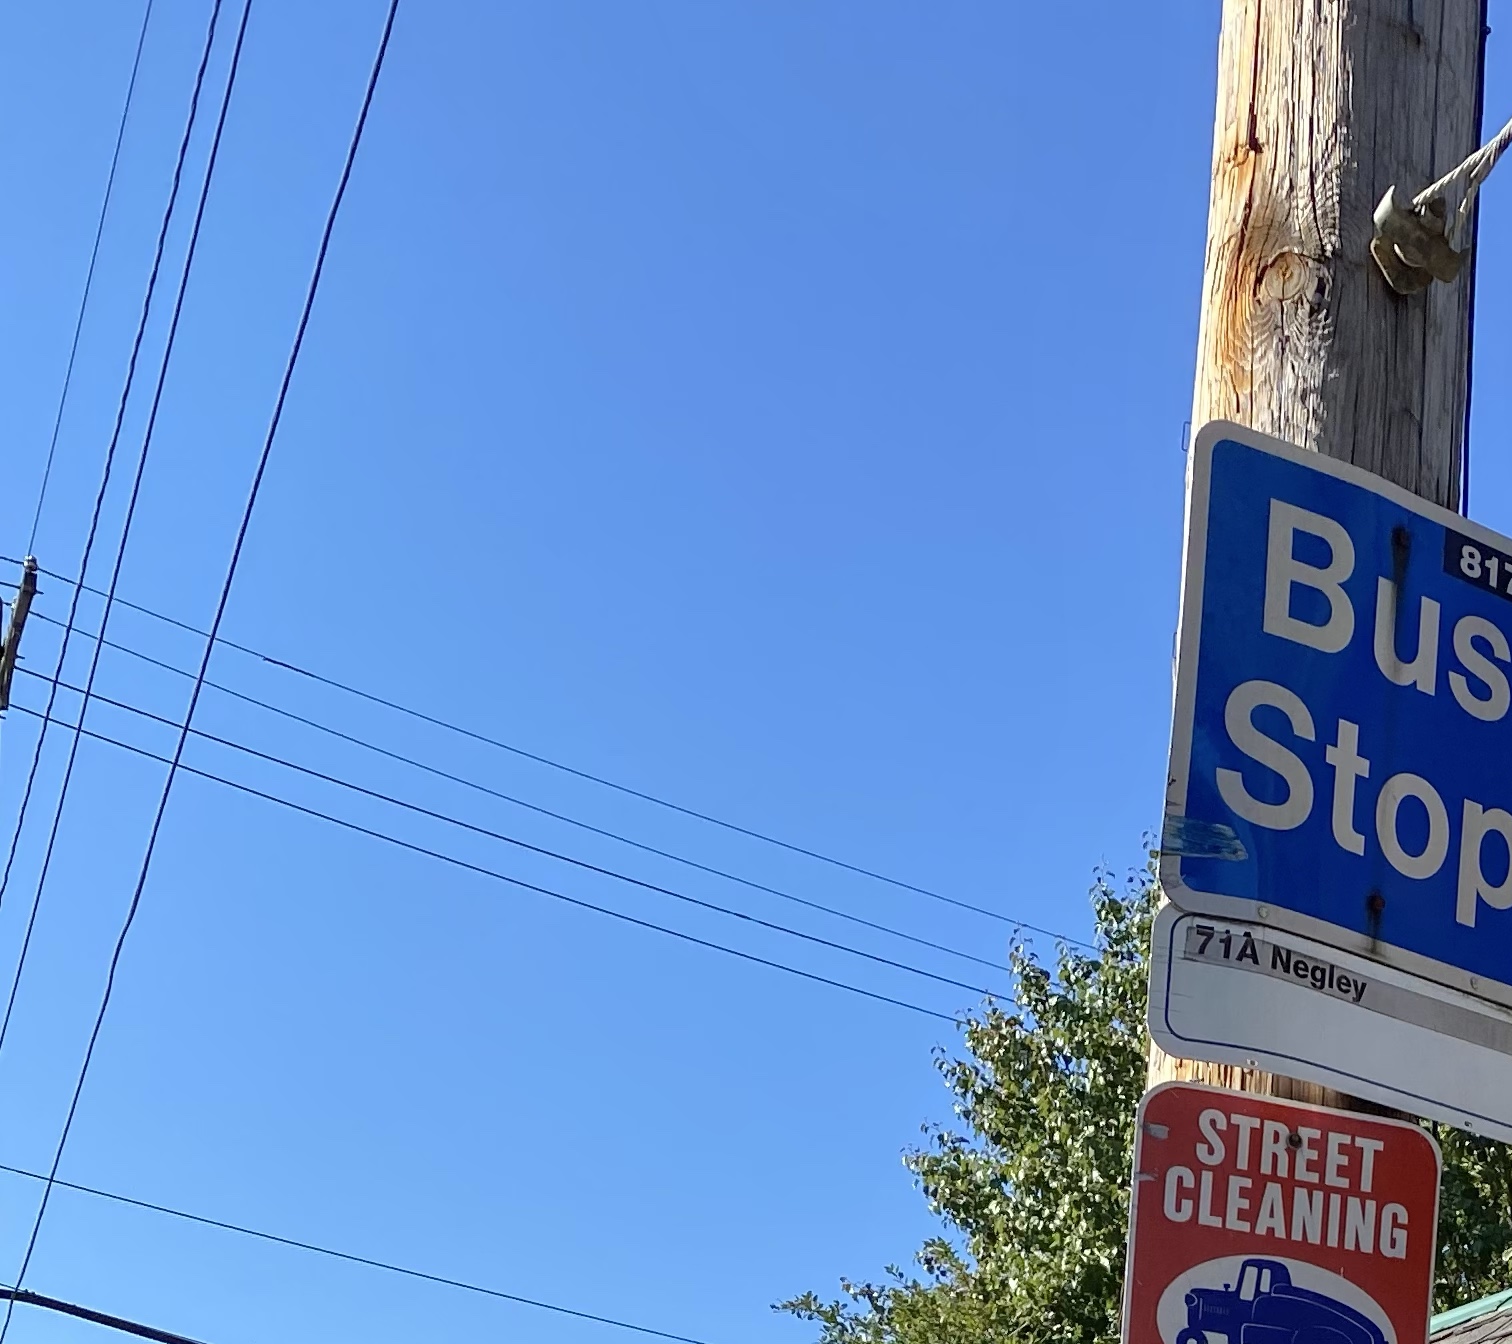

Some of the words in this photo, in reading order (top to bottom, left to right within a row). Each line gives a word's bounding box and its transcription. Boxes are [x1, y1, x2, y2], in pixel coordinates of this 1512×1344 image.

[1262, 497, 1512, 722] Bus
[1195, 924, 1260, 966] 71A
[1270, 944, 1368, 1003] Negley
[1195, 1108, 1385, 1193] STREET
[1163, 1165, 1409, 1260] CLEANING
